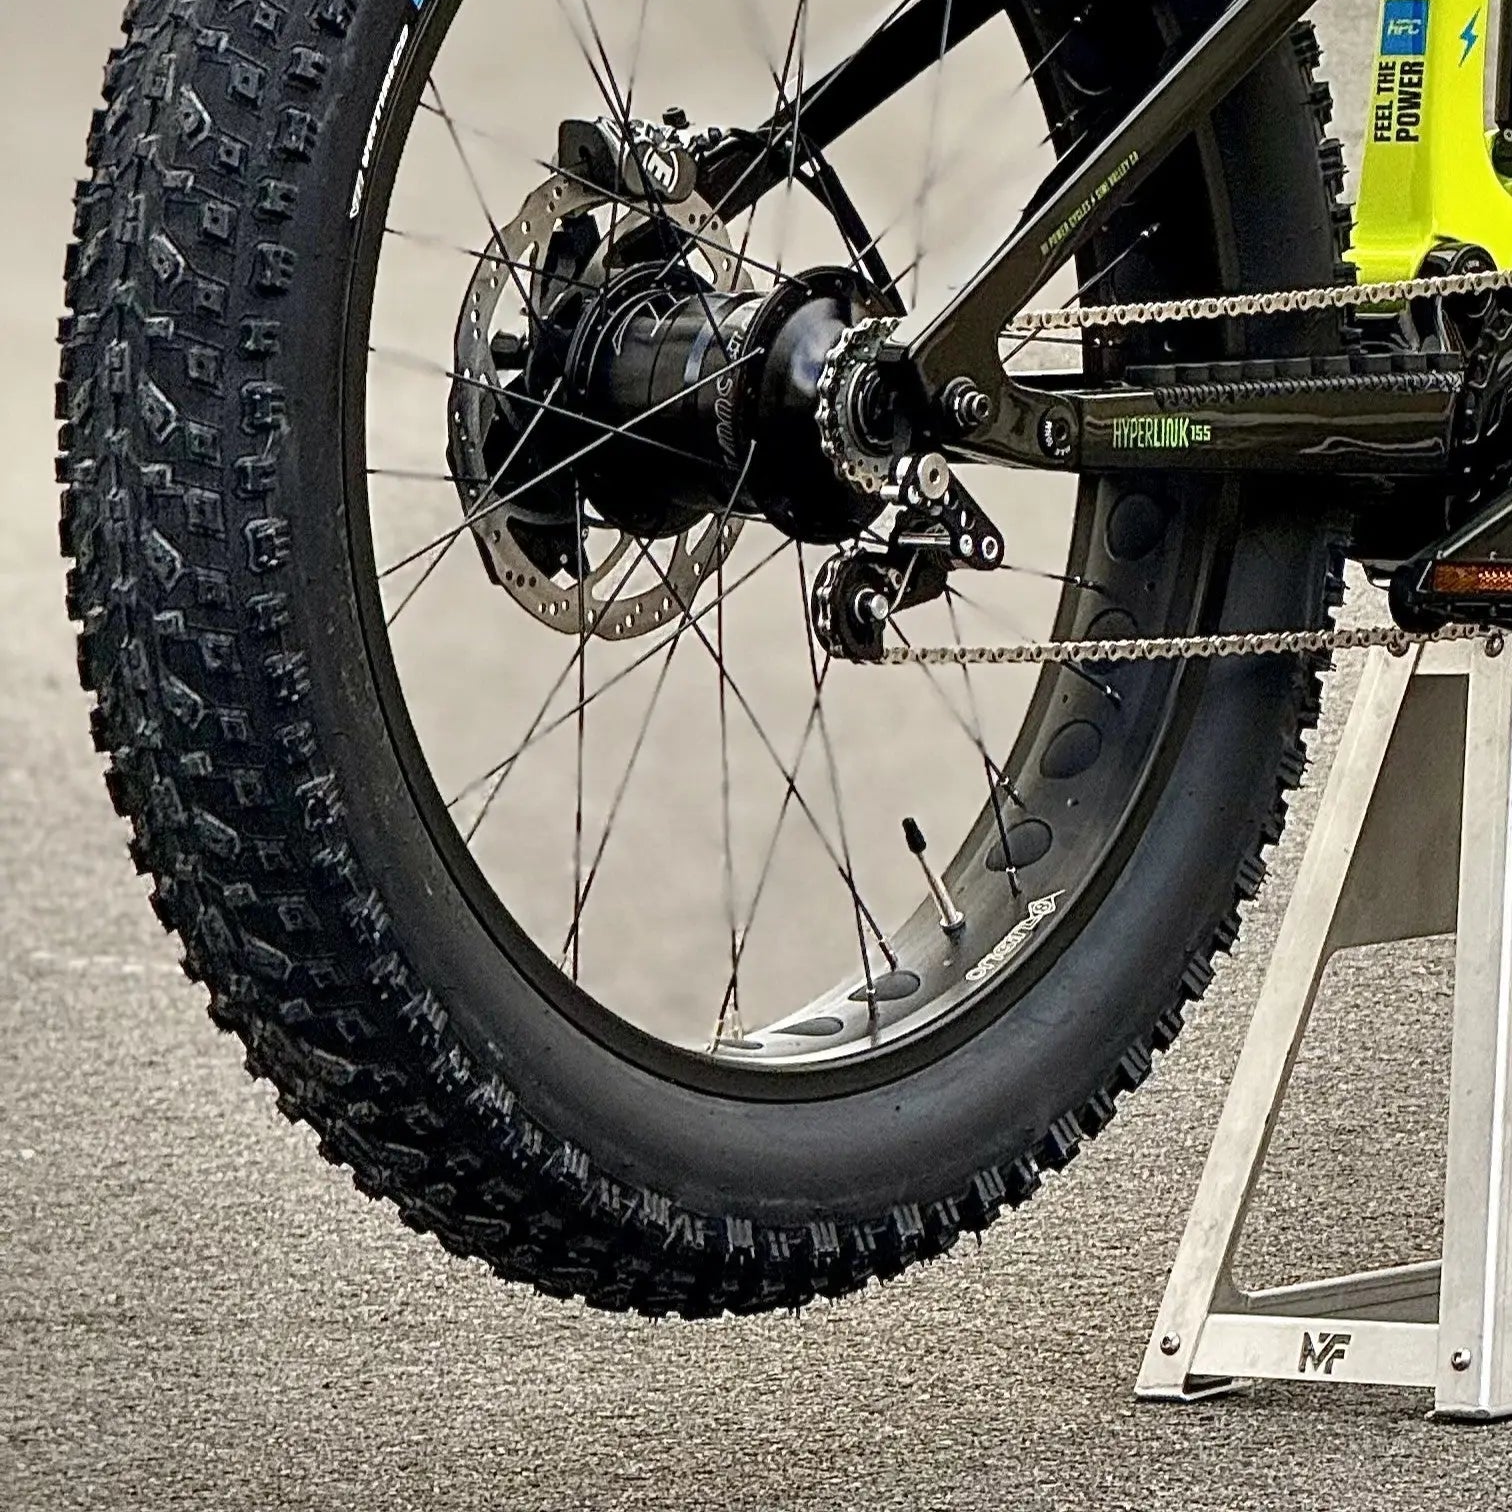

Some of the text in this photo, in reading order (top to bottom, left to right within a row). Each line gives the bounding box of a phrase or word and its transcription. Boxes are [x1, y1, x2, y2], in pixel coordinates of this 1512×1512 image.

[1387, 19, 1421, 36] HPC
[1374, 61, 1396, 143] FEEL THE
[1396, 61, 1424, 142] POWER
